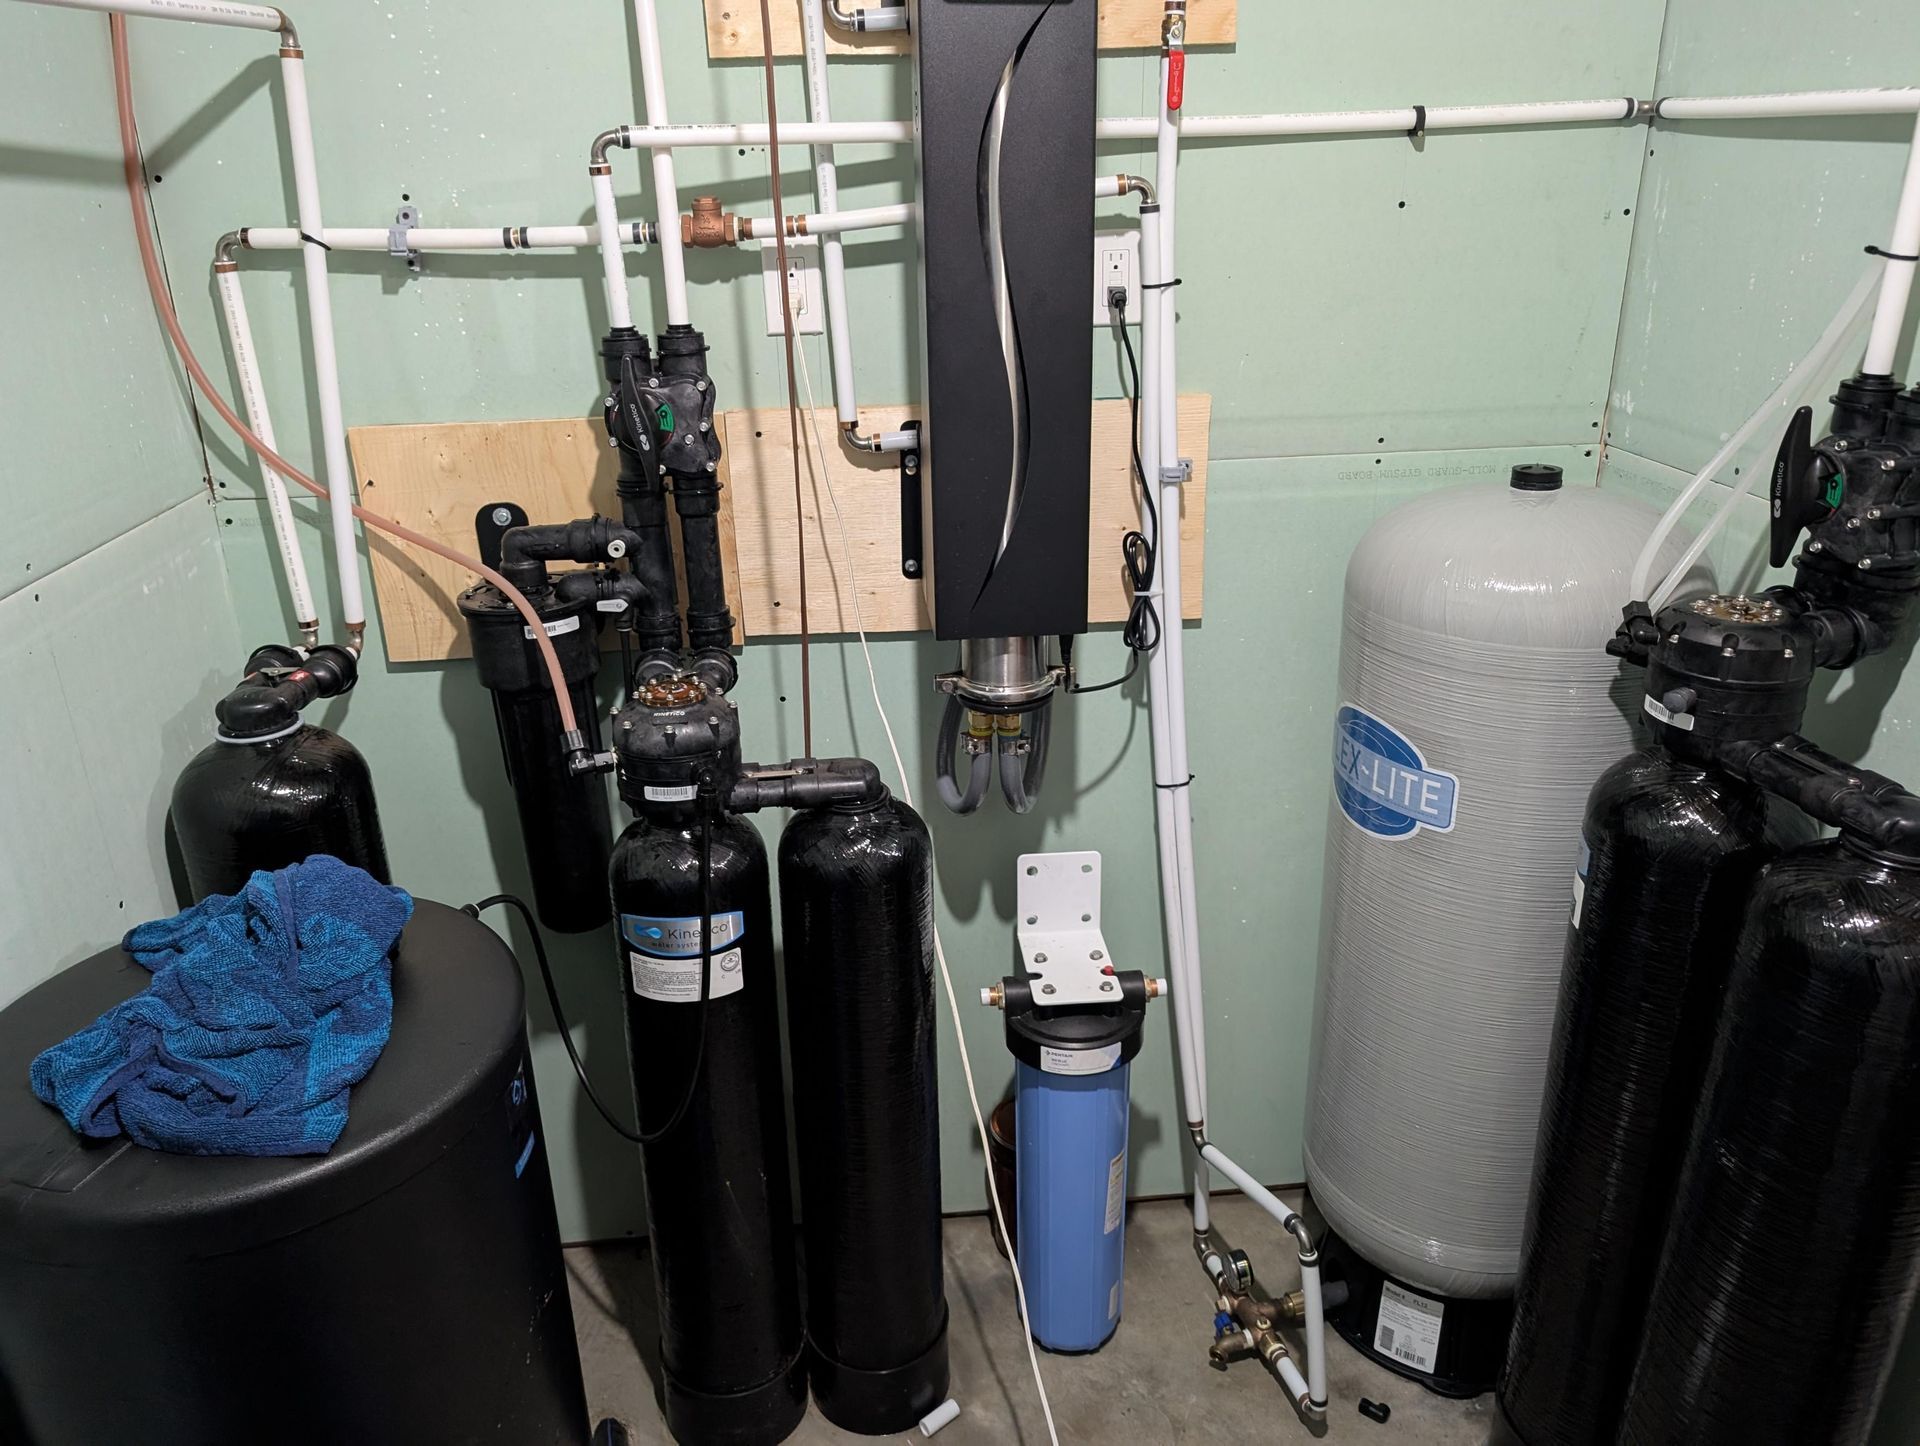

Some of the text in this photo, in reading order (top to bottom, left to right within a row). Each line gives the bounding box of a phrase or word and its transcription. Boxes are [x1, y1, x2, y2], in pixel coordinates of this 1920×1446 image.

[630, 403, 644, 433] Kinetico
[1338, 470, 1373, 481] BOARD
[1379, 468, 1422, 479] GYPSUM
[1427, 465, 1497, 477] MOLD-GUARD
[1775, 461, 1785, 497] Kinetico
[668, 923, 728, 940] Kineco
[652, 941, 674, 949] water
